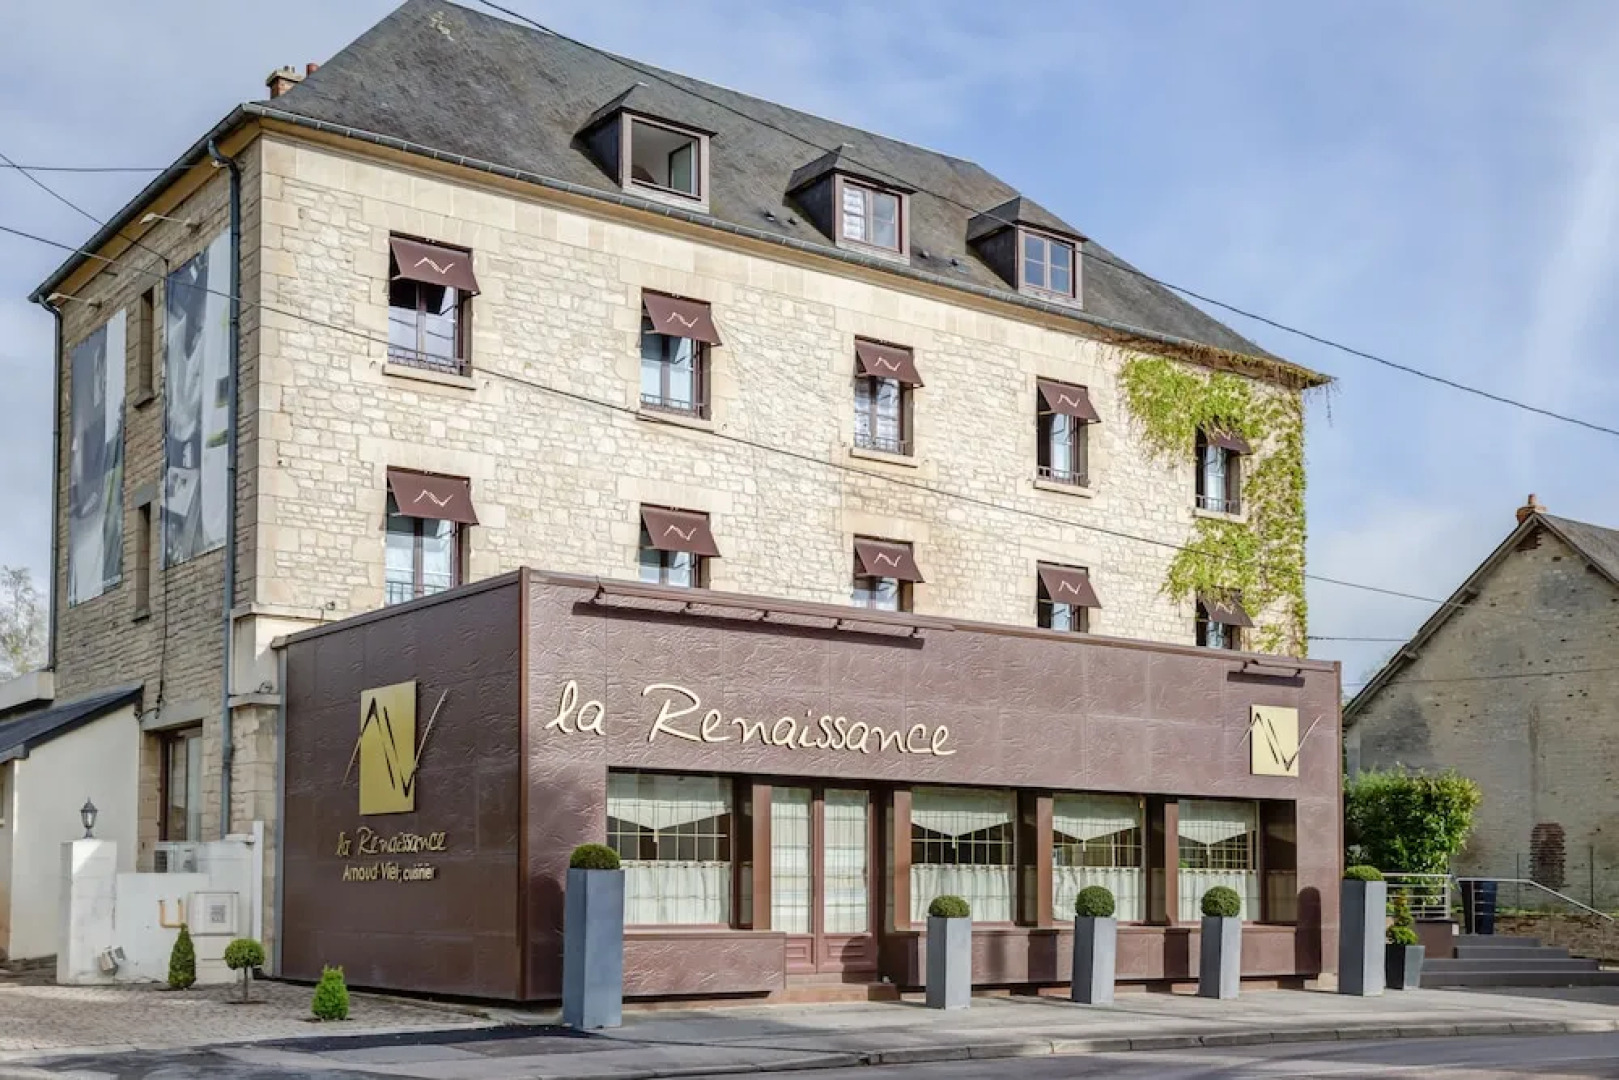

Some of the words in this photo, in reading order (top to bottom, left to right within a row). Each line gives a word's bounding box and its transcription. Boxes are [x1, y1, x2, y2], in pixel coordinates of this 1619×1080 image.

[545, 680, 606, 735] la
[641, 684, 957, 756] Renaissance
[335, 831, 351, 856] la
[356, 826, 447, 855] Renaissance
